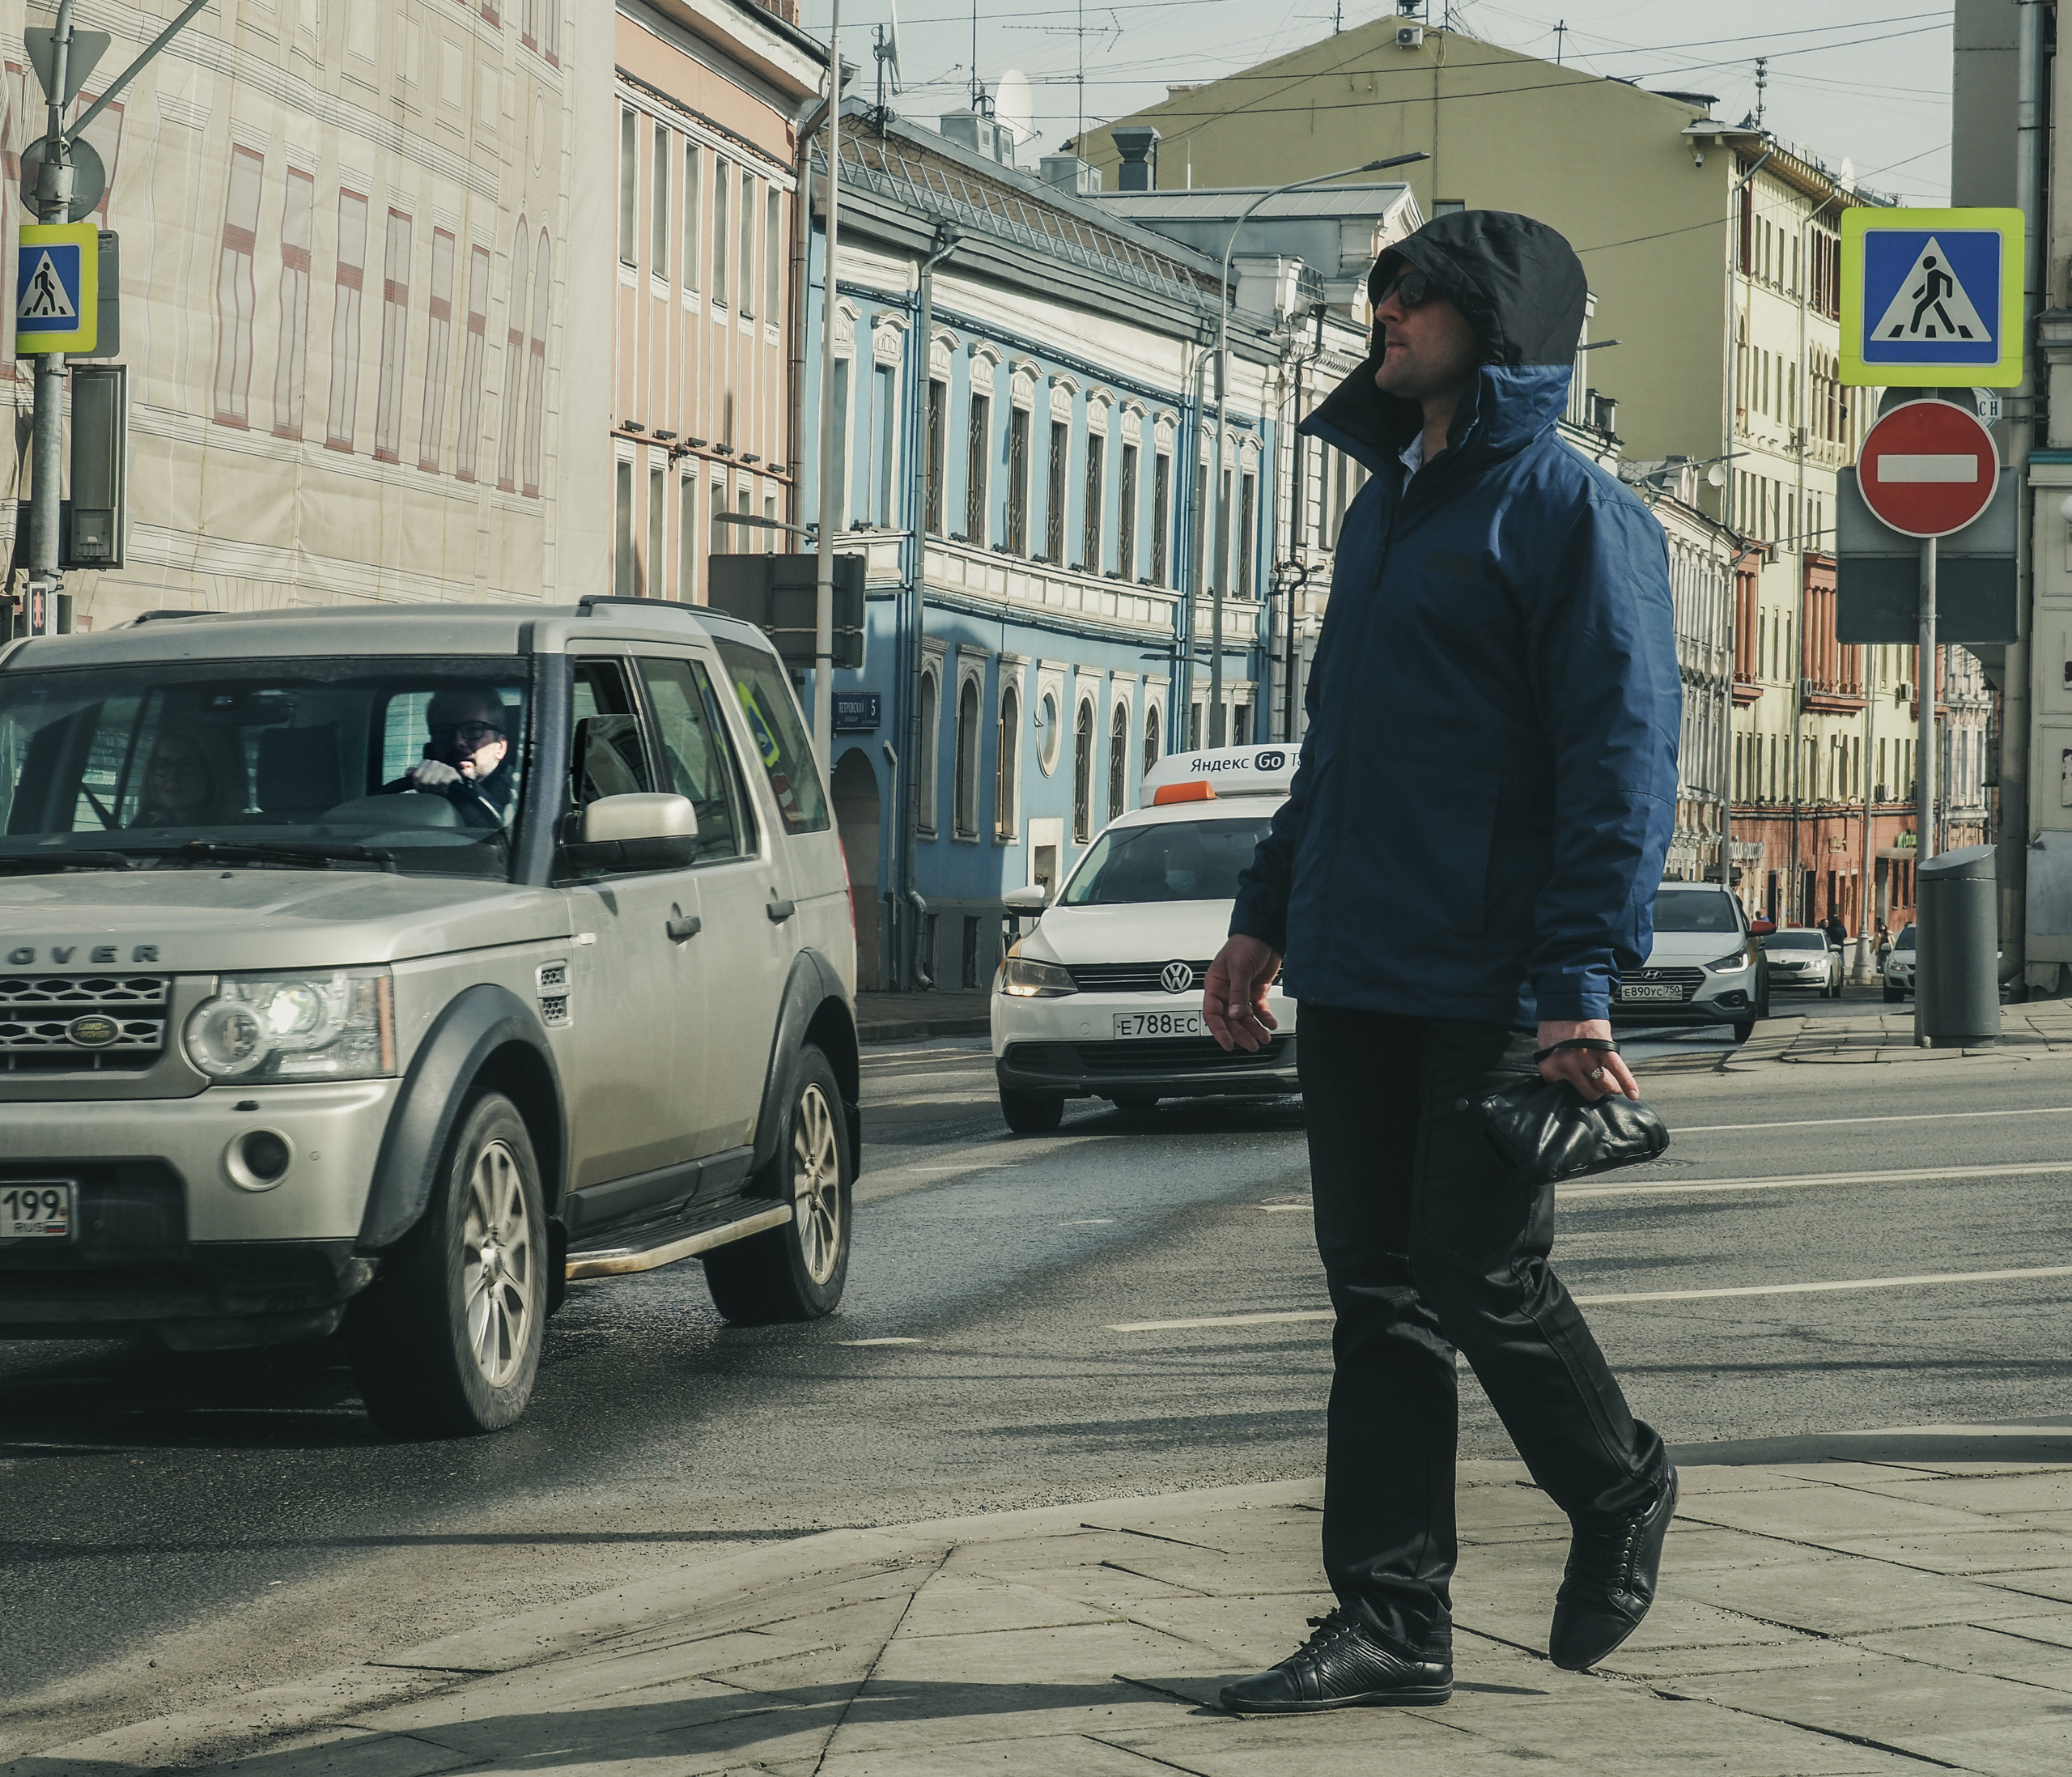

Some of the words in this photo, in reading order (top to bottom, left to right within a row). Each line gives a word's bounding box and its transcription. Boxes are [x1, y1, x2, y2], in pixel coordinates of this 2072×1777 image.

[871, 699, 876, 716] 5
[1191, 758, 1250, 772] Яндекс
[1258, 753, 1282, 768] Go
[1664, 985, 1679, 994] 750
[1120, 1014, 1199, 1035] Е788ЕС
[2, 1189, 60, 1220] 199
[14, 1222, 45, 1233] RUS
